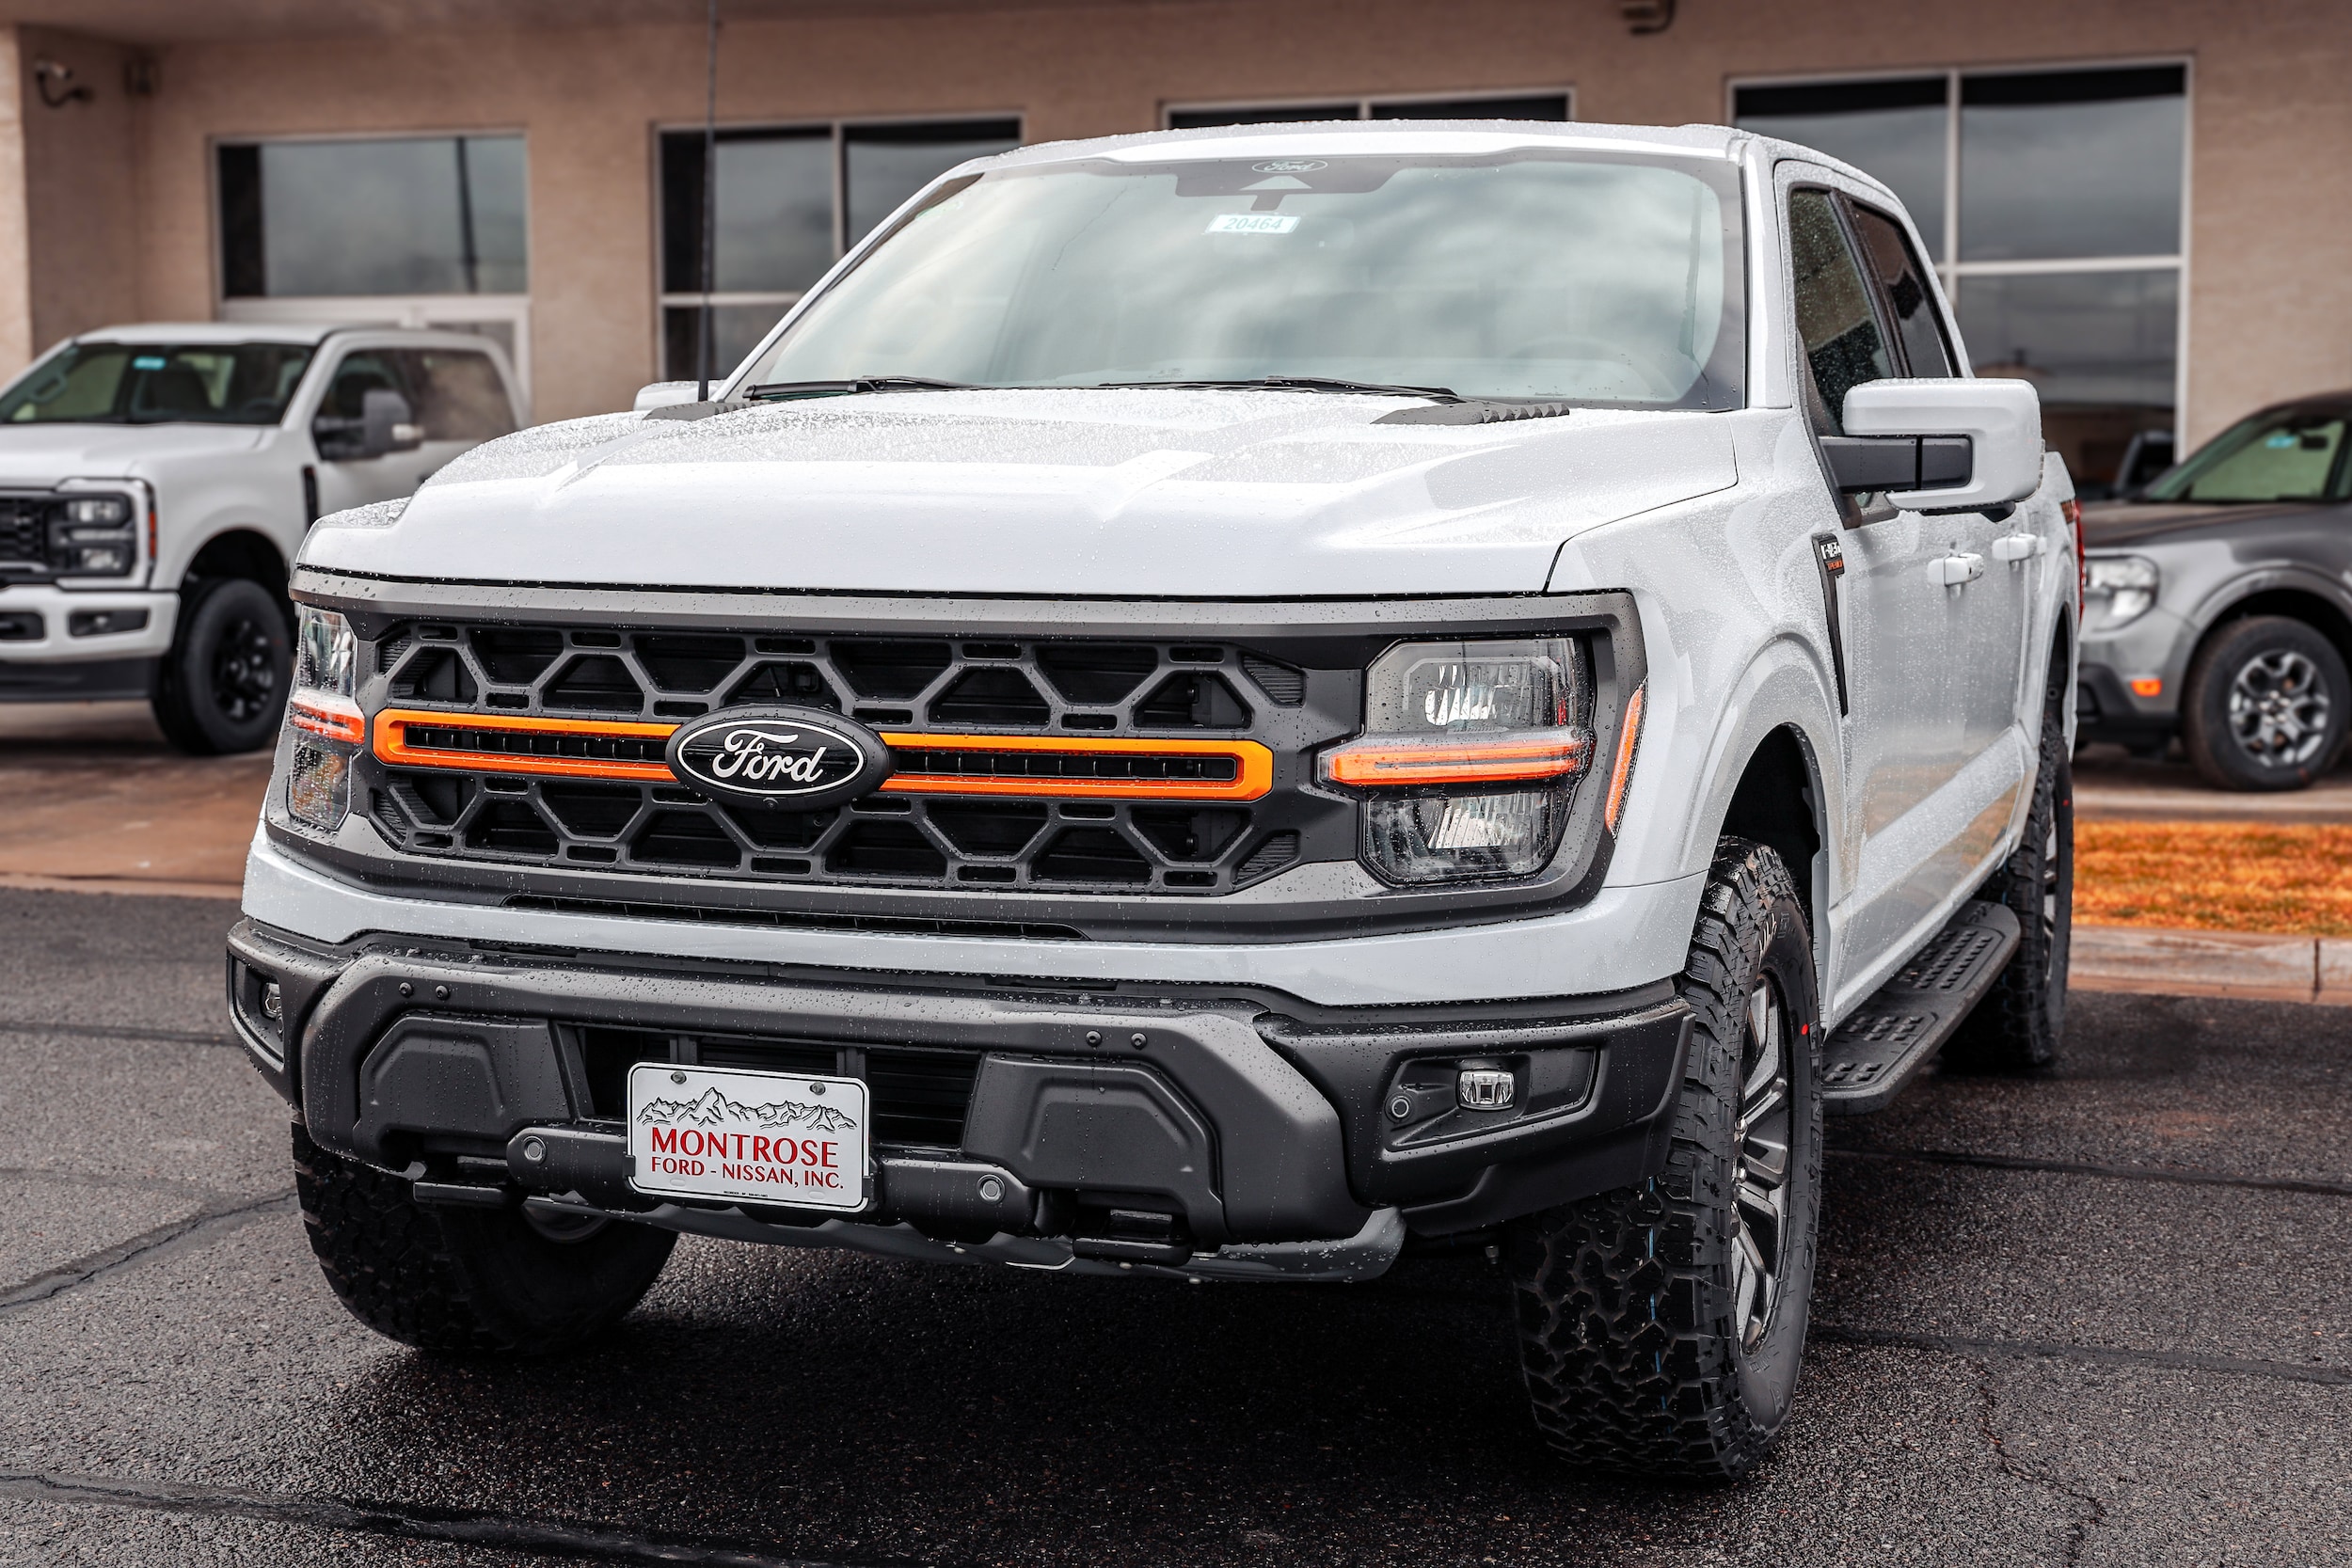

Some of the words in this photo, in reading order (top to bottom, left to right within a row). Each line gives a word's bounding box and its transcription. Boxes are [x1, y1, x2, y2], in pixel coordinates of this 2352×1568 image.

[1263, 160, 1316, 171] Ford
[1223, 217, 1284, 231] 20464
[712, 729, 827, 783] Ford
[650, 1127, 839, 1169] MONTROSE
[651, 1156, 705, 1177] FORD
[723, 1164, 799, 1189] NISSAN,
[804, 1170, 845, 1190] INC.
